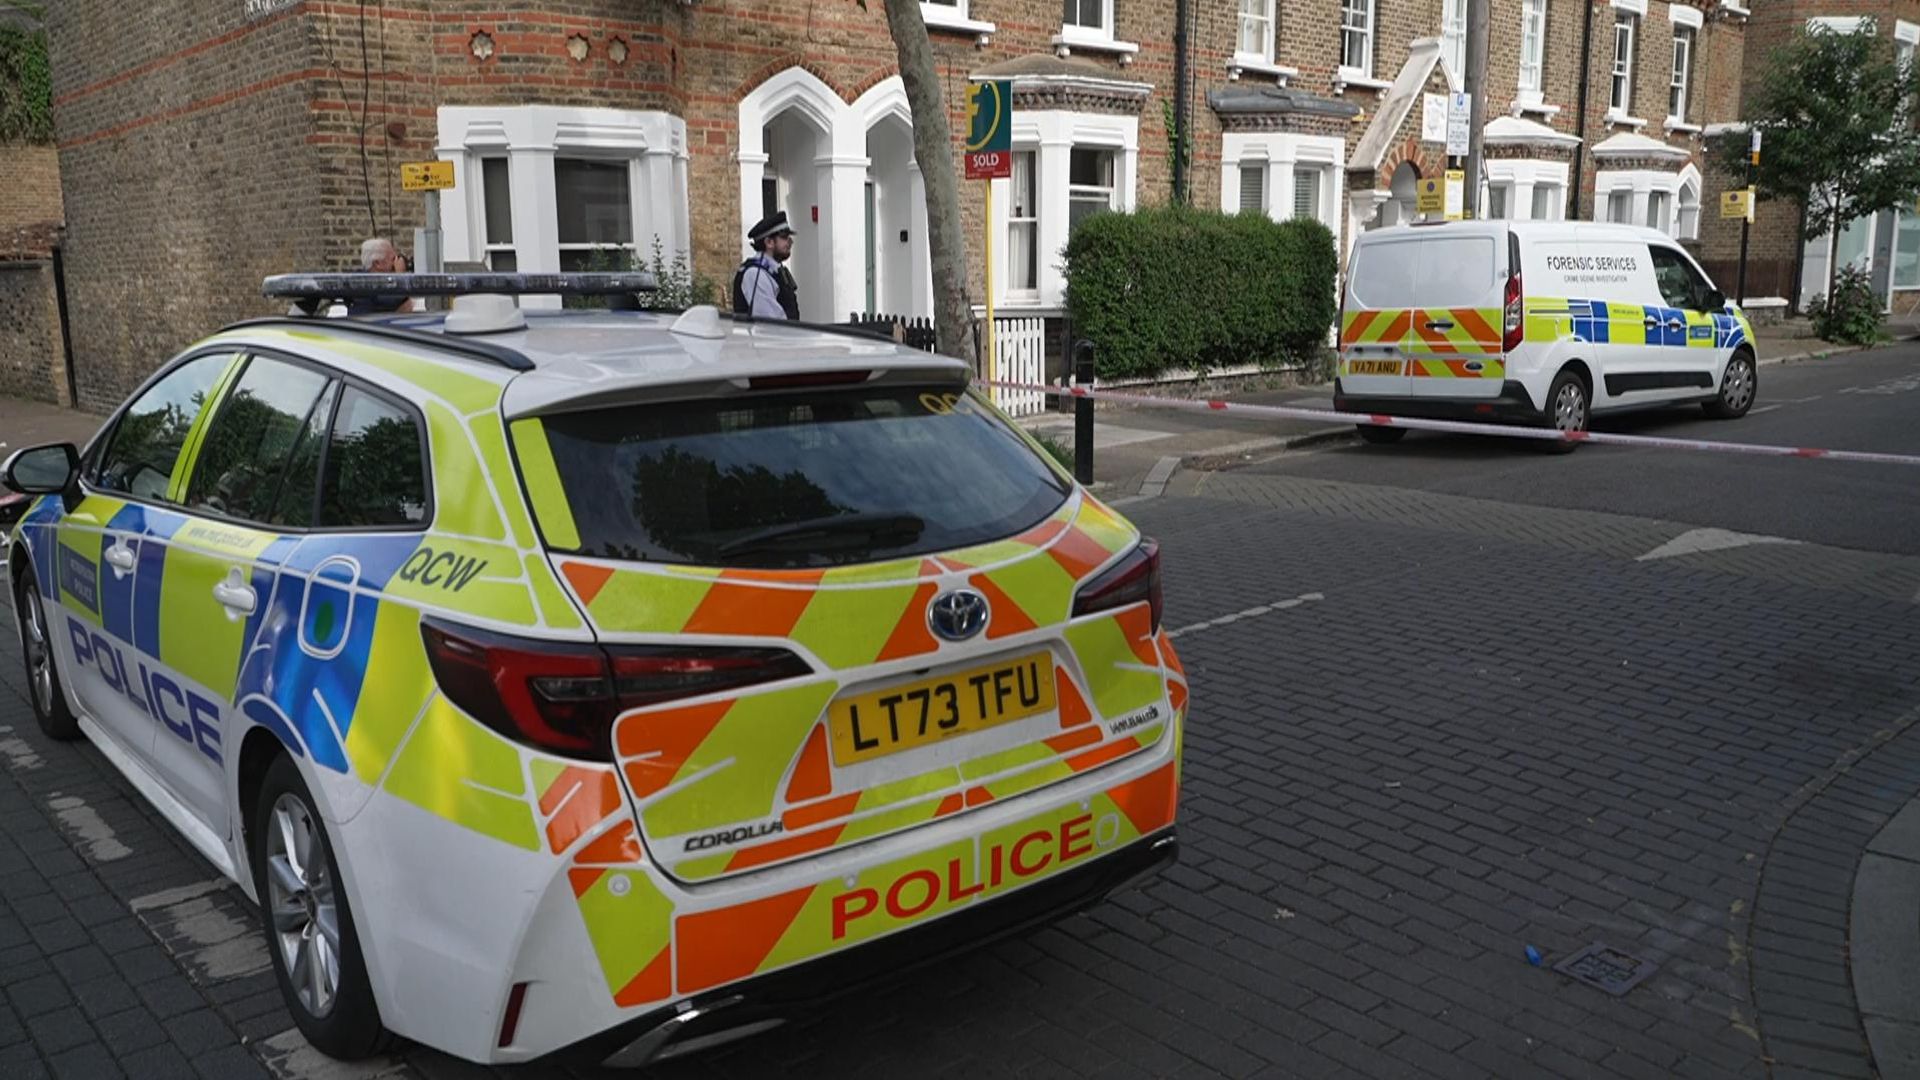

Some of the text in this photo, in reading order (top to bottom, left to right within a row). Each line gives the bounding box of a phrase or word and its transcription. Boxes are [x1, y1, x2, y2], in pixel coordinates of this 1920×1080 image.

[973, 152, 999, 168] SOLD
[1547, 257, 1637, 271] FORENSIC SERVICES
[1377, 361, 1397, 373] ANU
[400, 546, 488, 592] QCW
[67, 615, 225, 770] POLICE
[850, 682, 960, 752] LT73
[968, 661, 1040, 720] TFU
[684, 821, 784, 853] COROLLA
[832, 813, 1093, 941] POLICE
